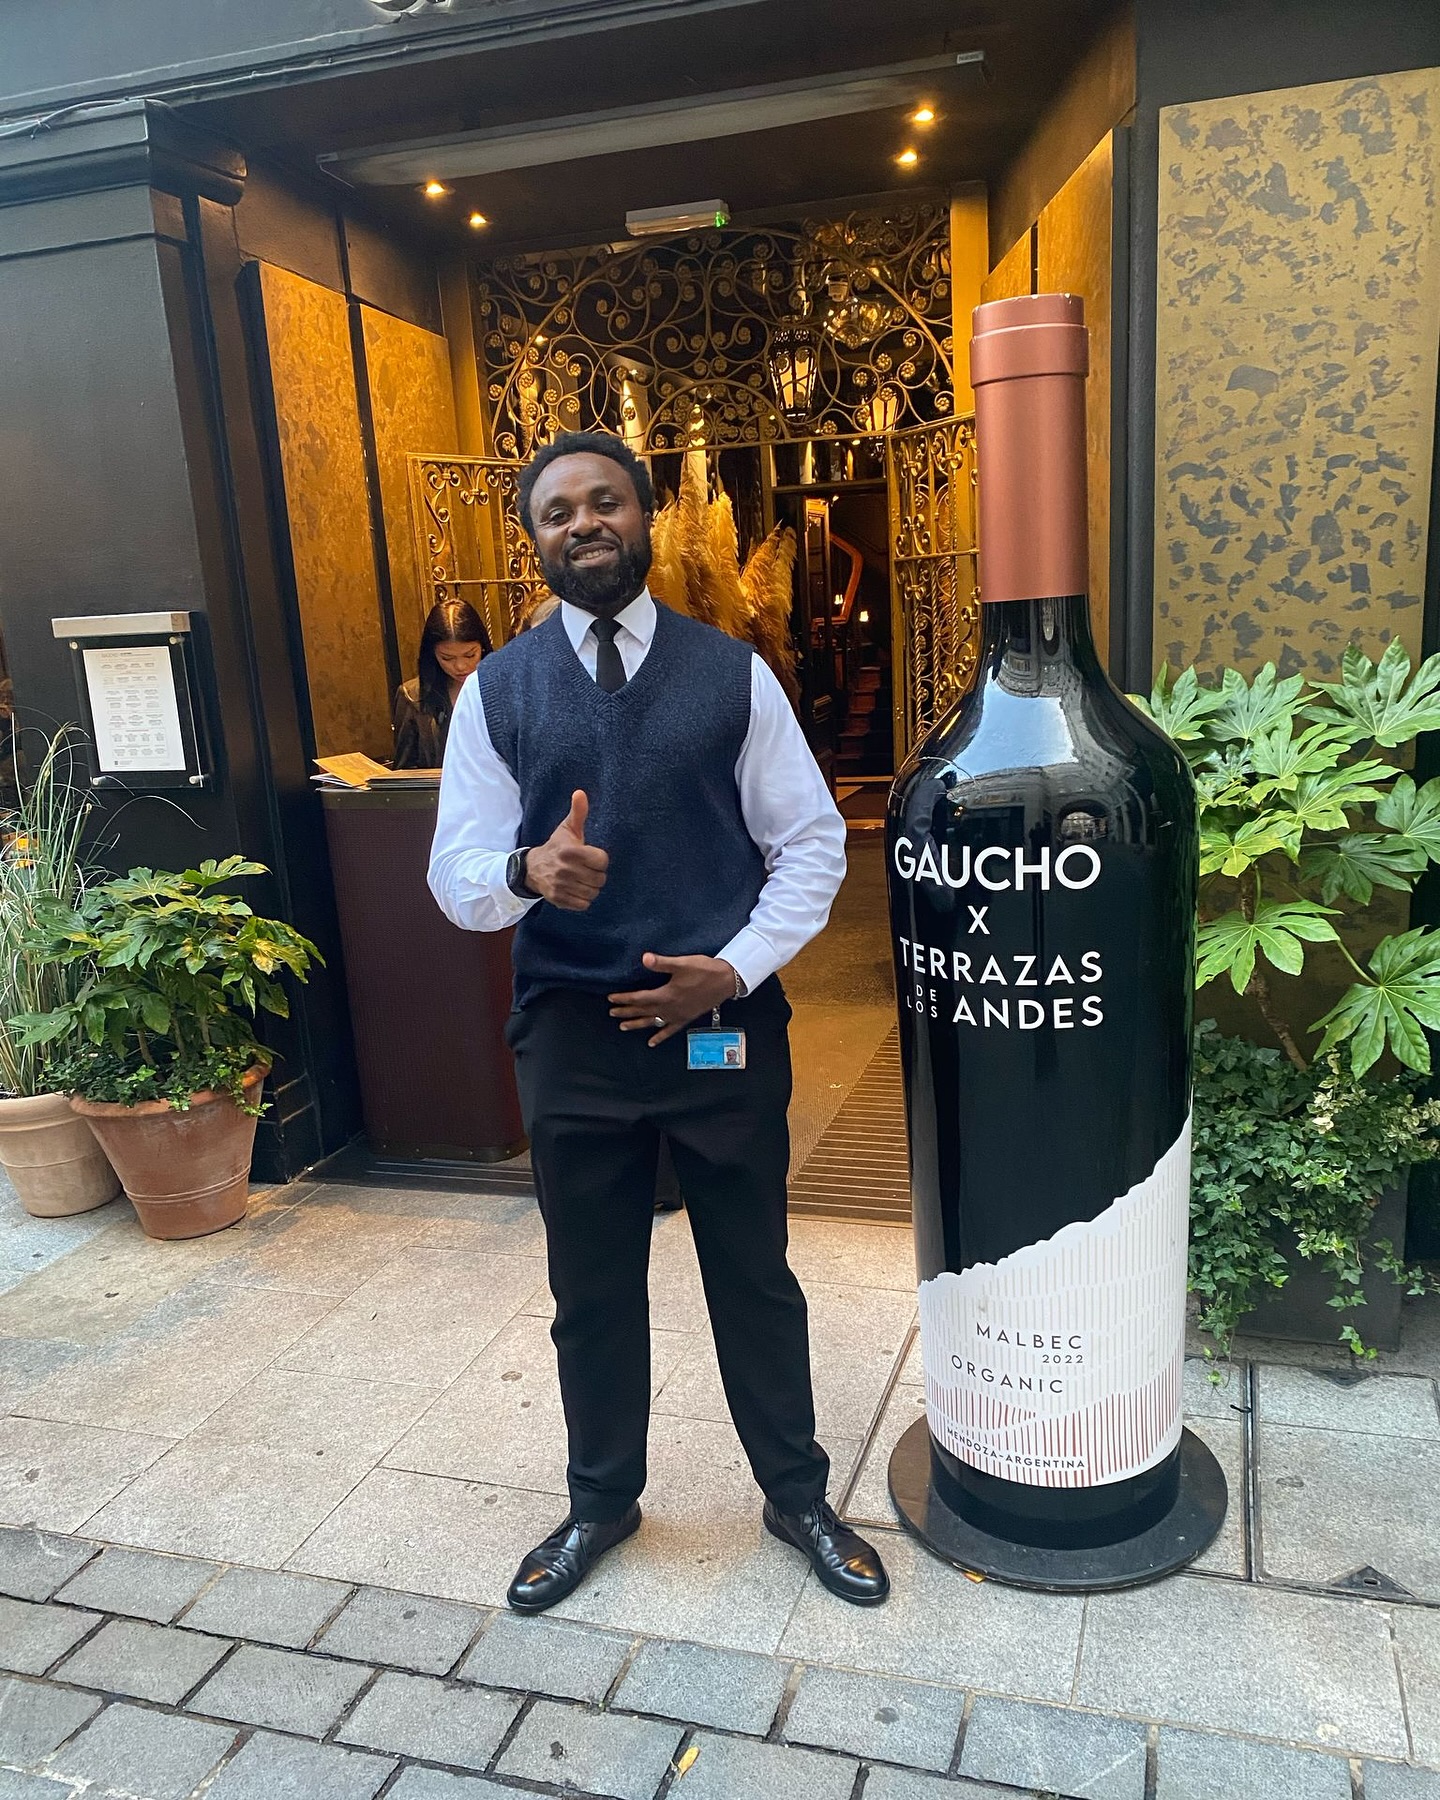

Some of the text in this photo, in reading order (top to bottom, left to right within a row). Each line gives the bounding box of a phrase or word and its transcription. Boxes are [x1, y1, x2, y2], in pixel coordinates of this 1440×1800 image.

[894, 836, 1101, 891] GAUCHO
[967, 905, 991, 935] X
[899, 936, 1103, 987] TERRAZAS
[906, 995, 938, 1018] LOS
[916, 984, 937, 1002] DE
[952, 994, 1104, 1030] ANDES
[976, 1322, 1082, 1349] MALBEC
[951, 1354, 1063, 1394] ORGANIC
[1042, 1354, 1084, 1364] 2022
